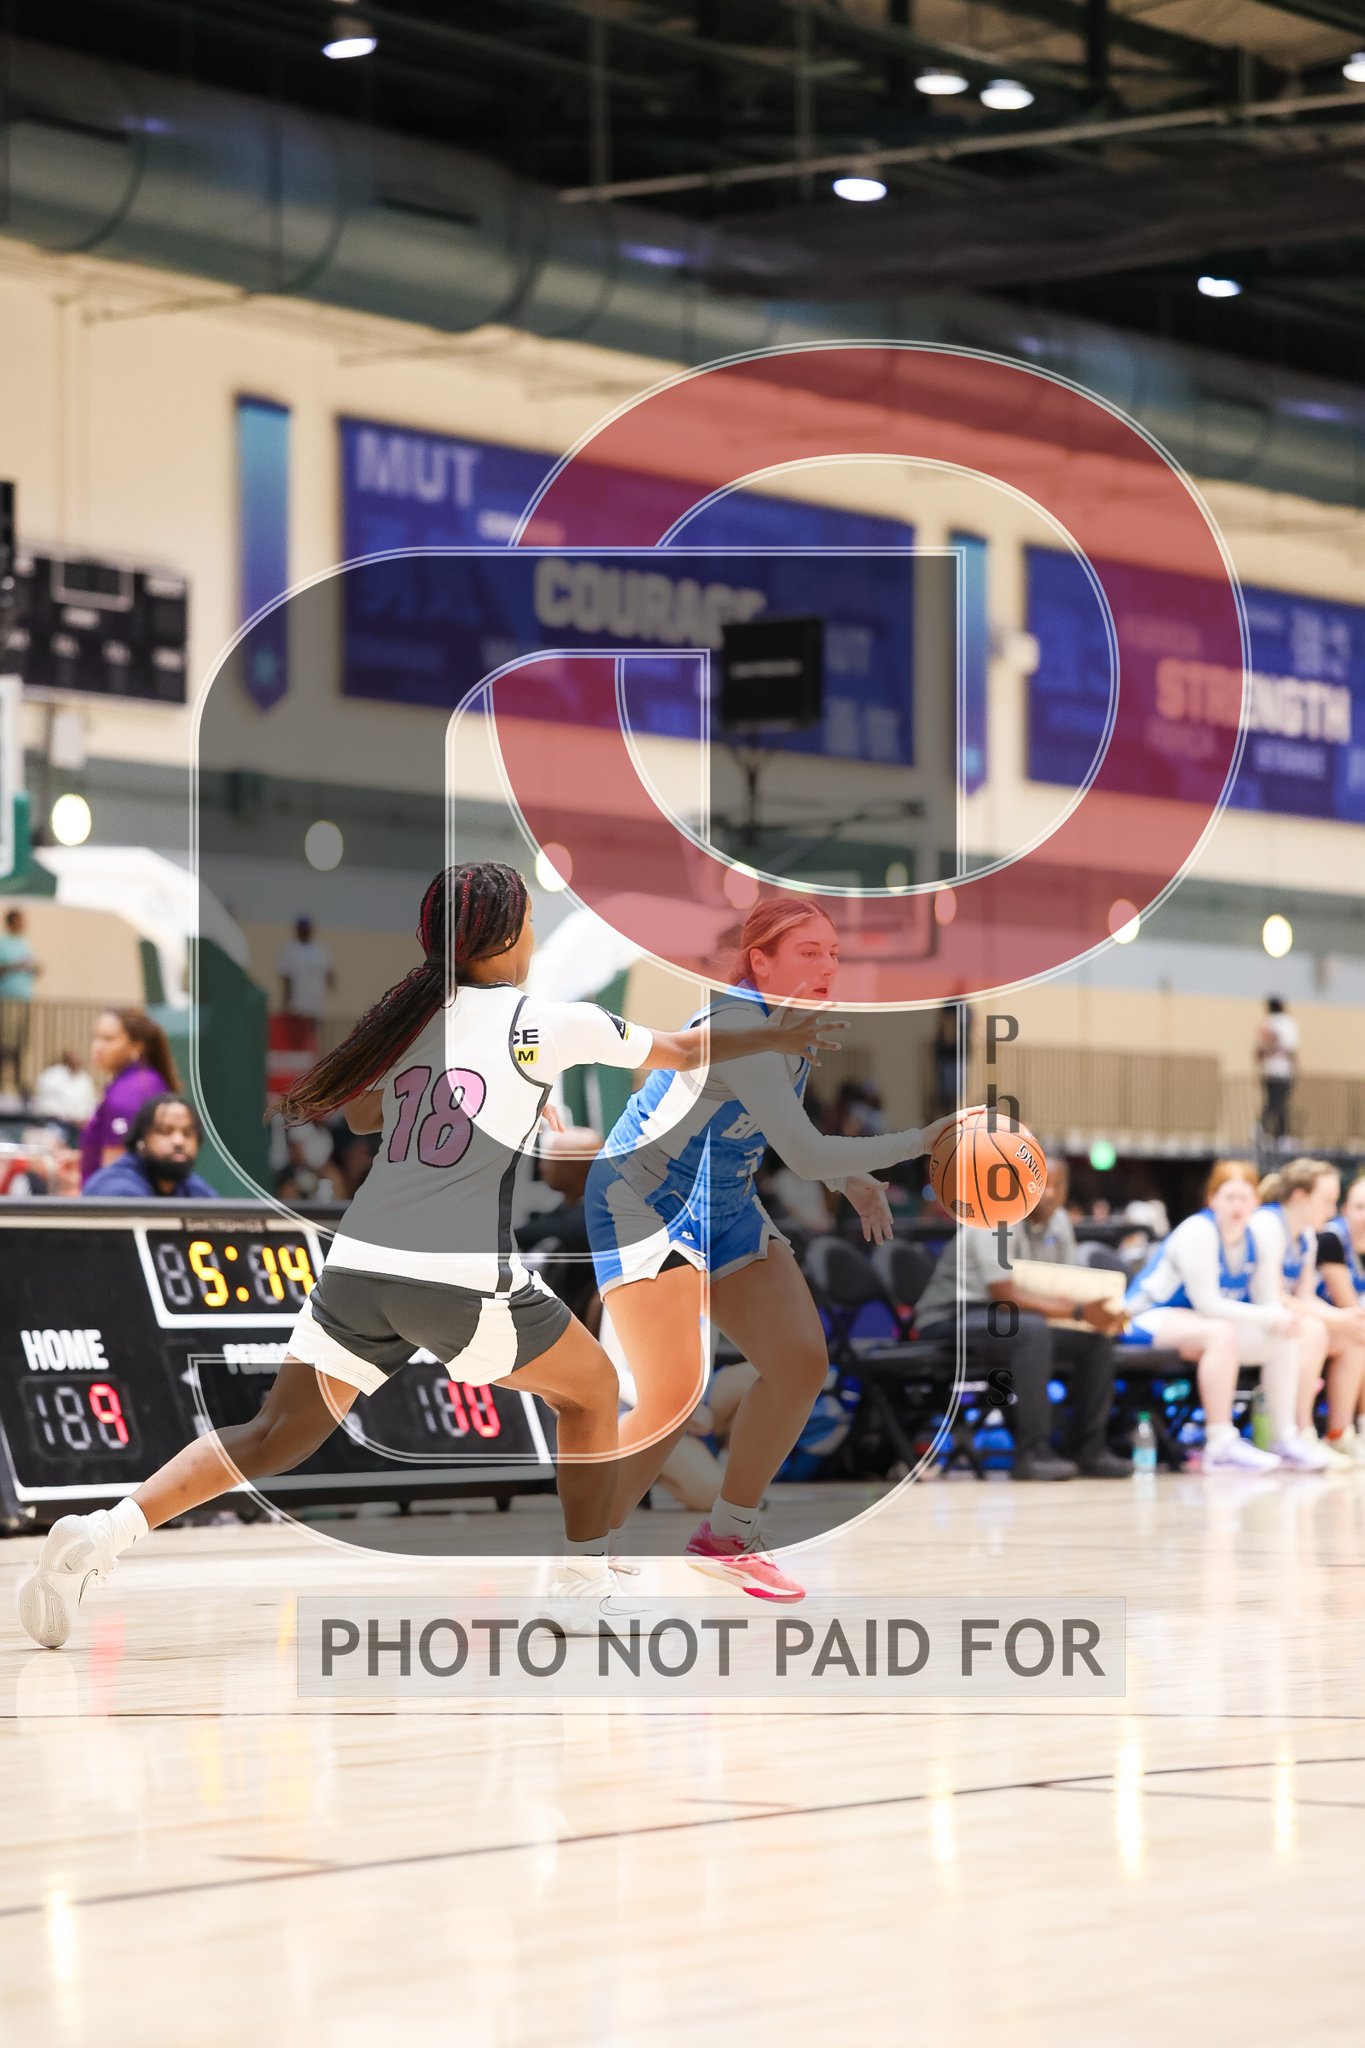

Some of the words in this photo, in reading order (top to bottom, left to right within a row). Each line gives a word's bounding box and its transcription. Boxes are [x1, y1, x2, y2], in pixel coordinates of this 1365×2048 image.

[357, 431, 478, 507] MUT
[388, 1066, 487, 1168] 18
[189, 1241, 314, 1306] 5:14
[20, 1329, 109, 1371] HOME
[89, 1383, 129, 1444] 9
